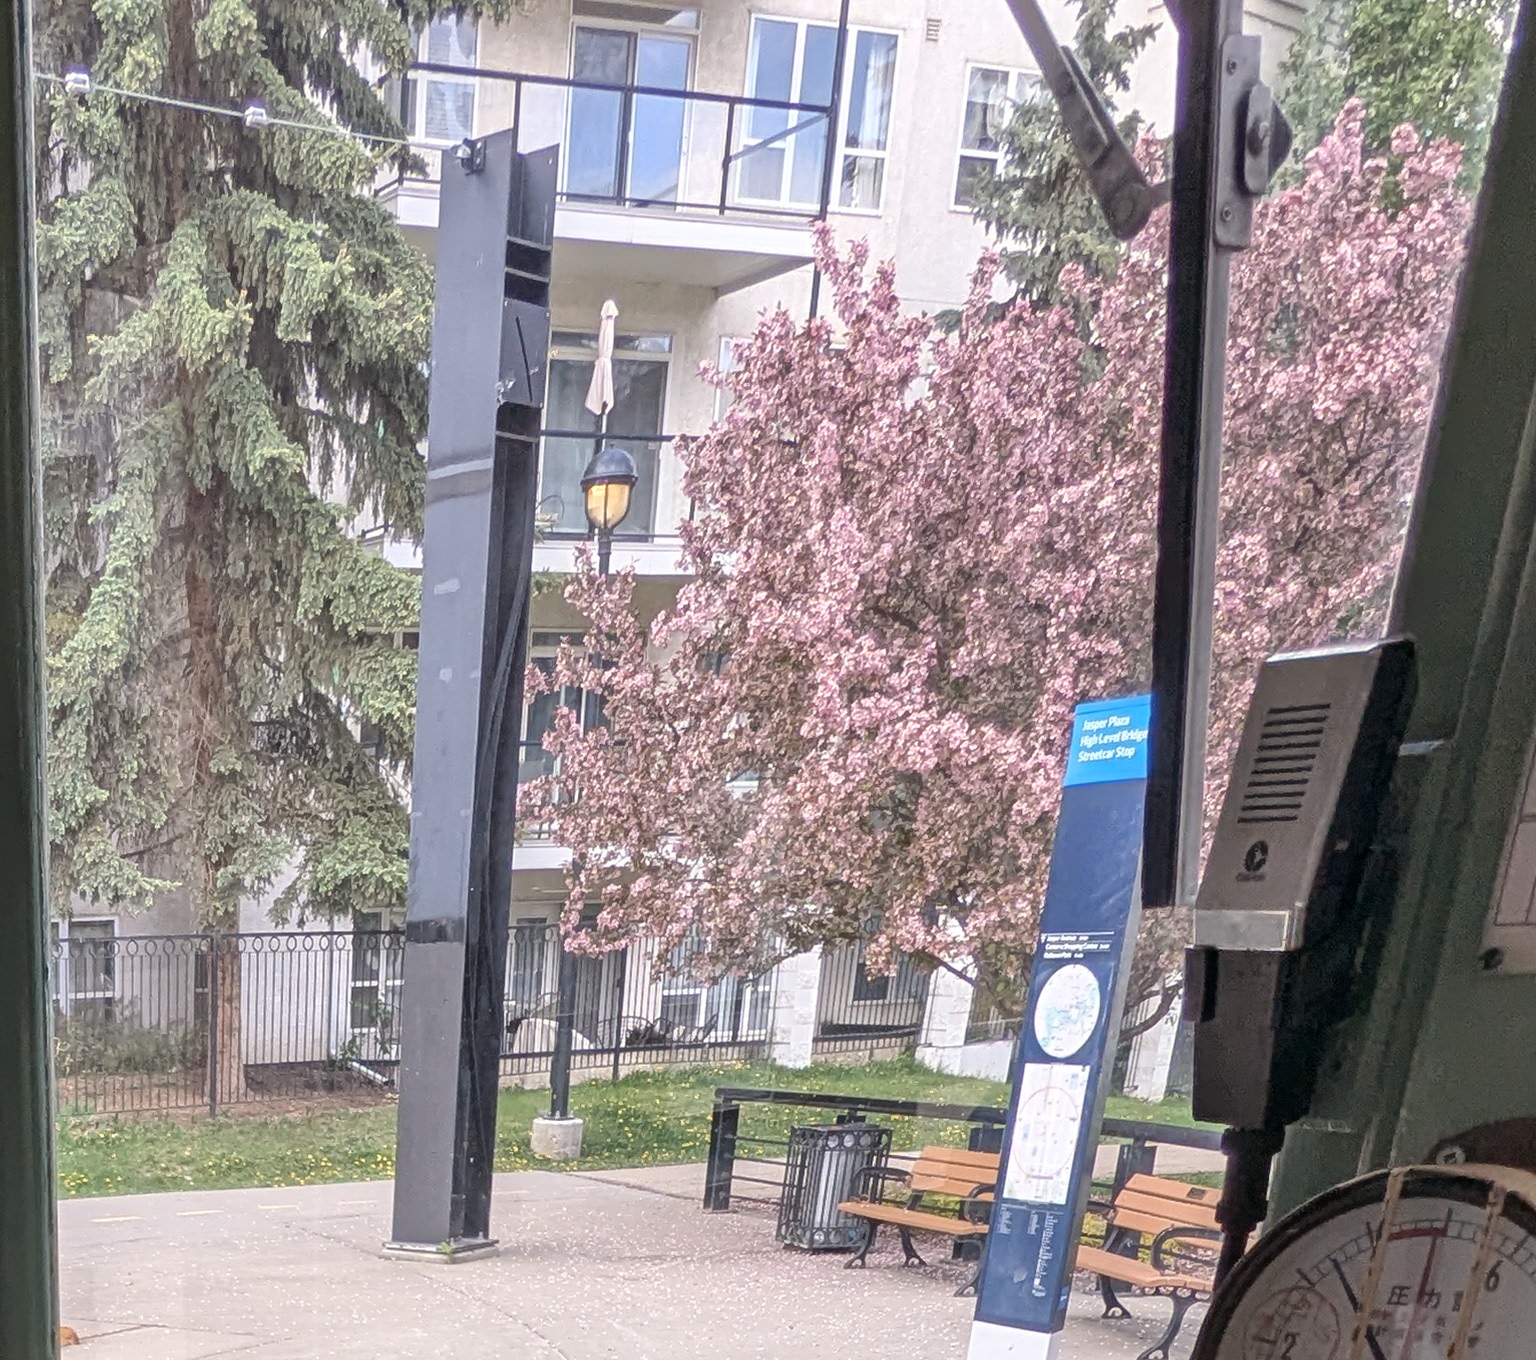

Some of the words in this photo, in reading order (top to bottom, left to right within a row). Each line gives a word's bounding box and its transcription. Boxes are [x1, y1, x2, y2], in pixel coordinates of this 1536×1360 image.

[1083, 720, 1107, 732] Jasper
[1108, 716, 1131, 727] Plaza
[1080, 734, 1099, 748] High
[1099, 733, 1121, 744] Level
[1077, 750, 1115, 762] Streetcar
[1115, 746, 1136, 758] Stop
[1484, 1259, 1503, 1292] 6
